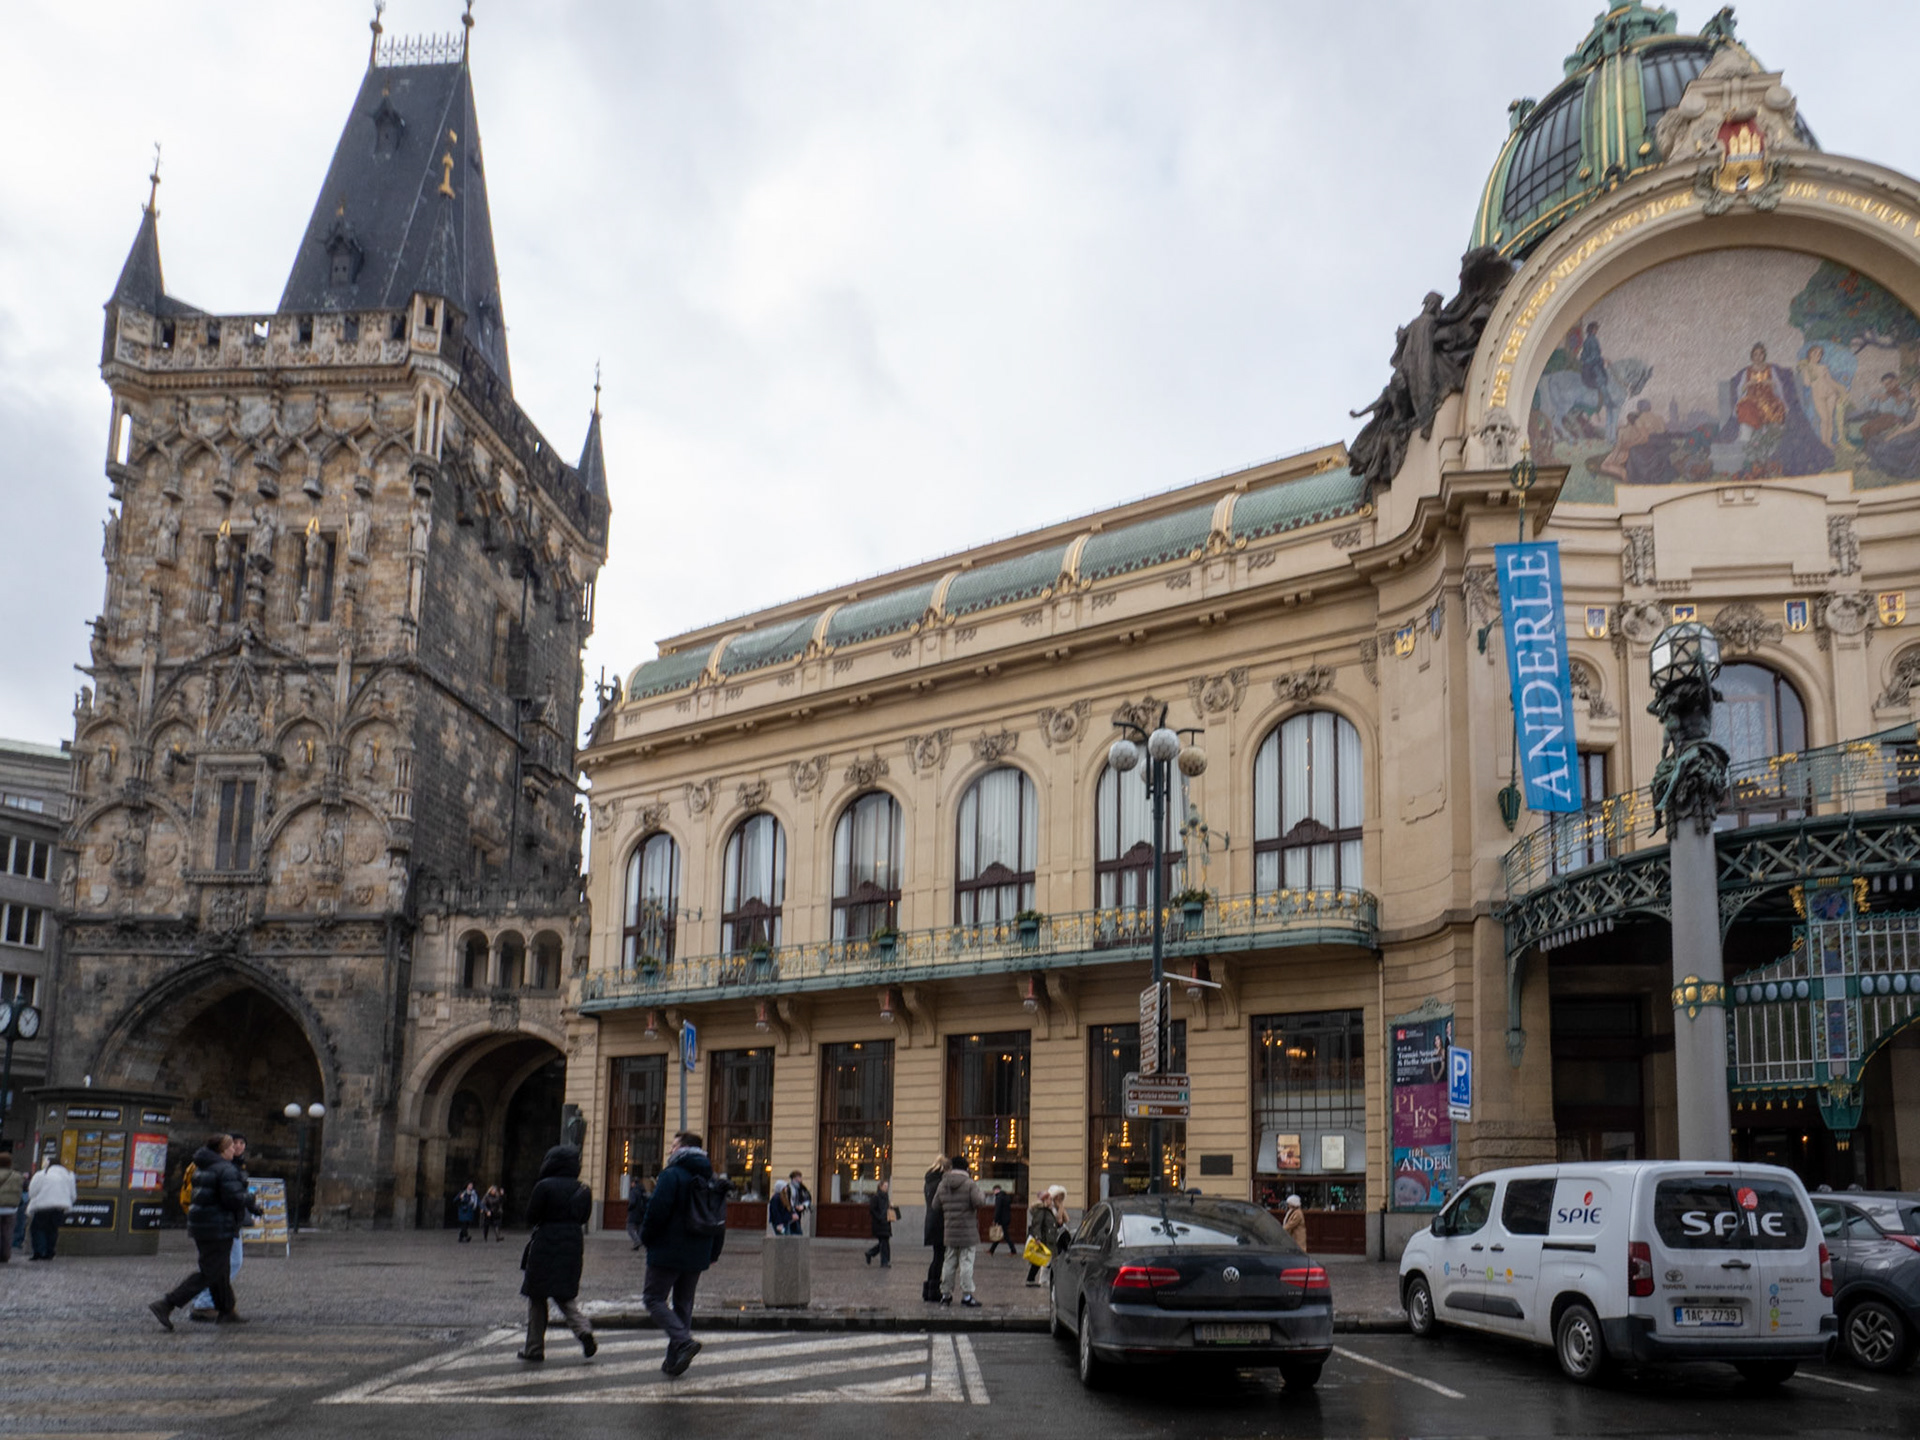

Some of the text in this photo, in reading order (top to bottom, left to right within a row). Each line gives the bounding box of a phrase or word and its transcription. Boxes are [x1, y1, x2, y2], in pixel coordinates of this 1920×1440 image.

[1507, 550, 1572, 803] ANDERLE
[1454, 1054, 1467, 1088] P
[1400, 1155, 1451, 1172] ANDERL
[1557, 1207, 1602, 1224] SPIE
[1681, 1211, 1787, 1237] SPIE
[1685, 1309, 1704, 1321] 1AC
